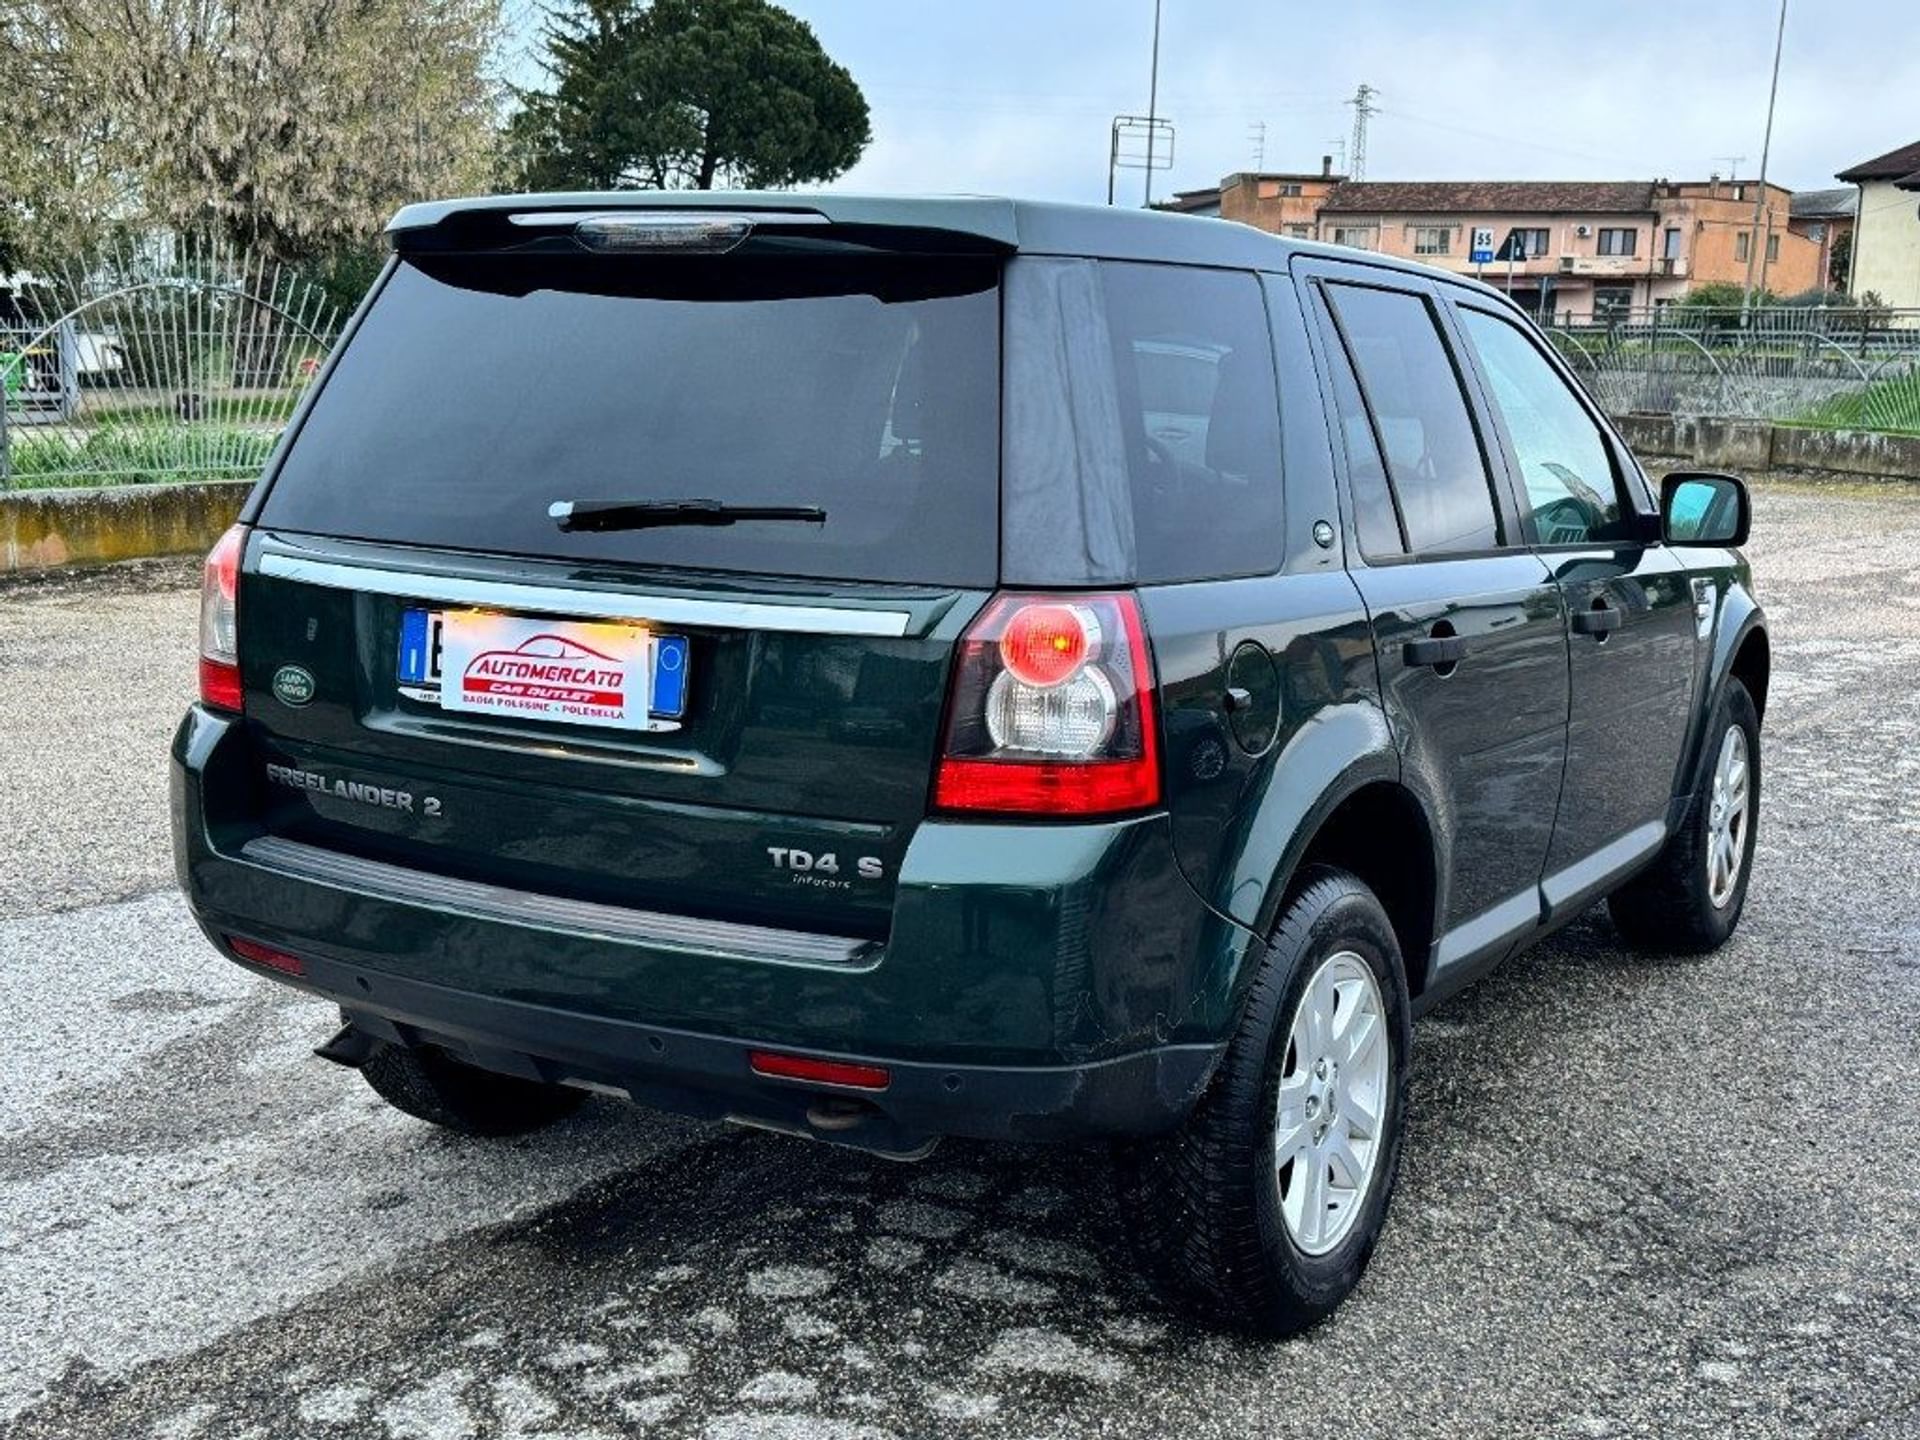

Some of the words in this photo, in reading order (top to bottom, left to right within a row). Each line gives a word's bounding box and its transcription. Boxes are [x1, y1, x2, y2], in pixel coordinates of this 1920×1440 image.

[477, 659, 624, 688] AUTOMERCATO
[463, 694, 495, 705] BADIA
[497, 698, 550, 712] POLESINE
[562, 704, 624, 719] POLESELLA
[489, 682, 525, 697] CAR
[527, 687, 596, 704] OUTLET
[266, 762, 414, 814] FREELANDER
[423, 796, 442, 816] 2
[766, 846, 840, 875] TD4
[857, 856, 883, 879] S
